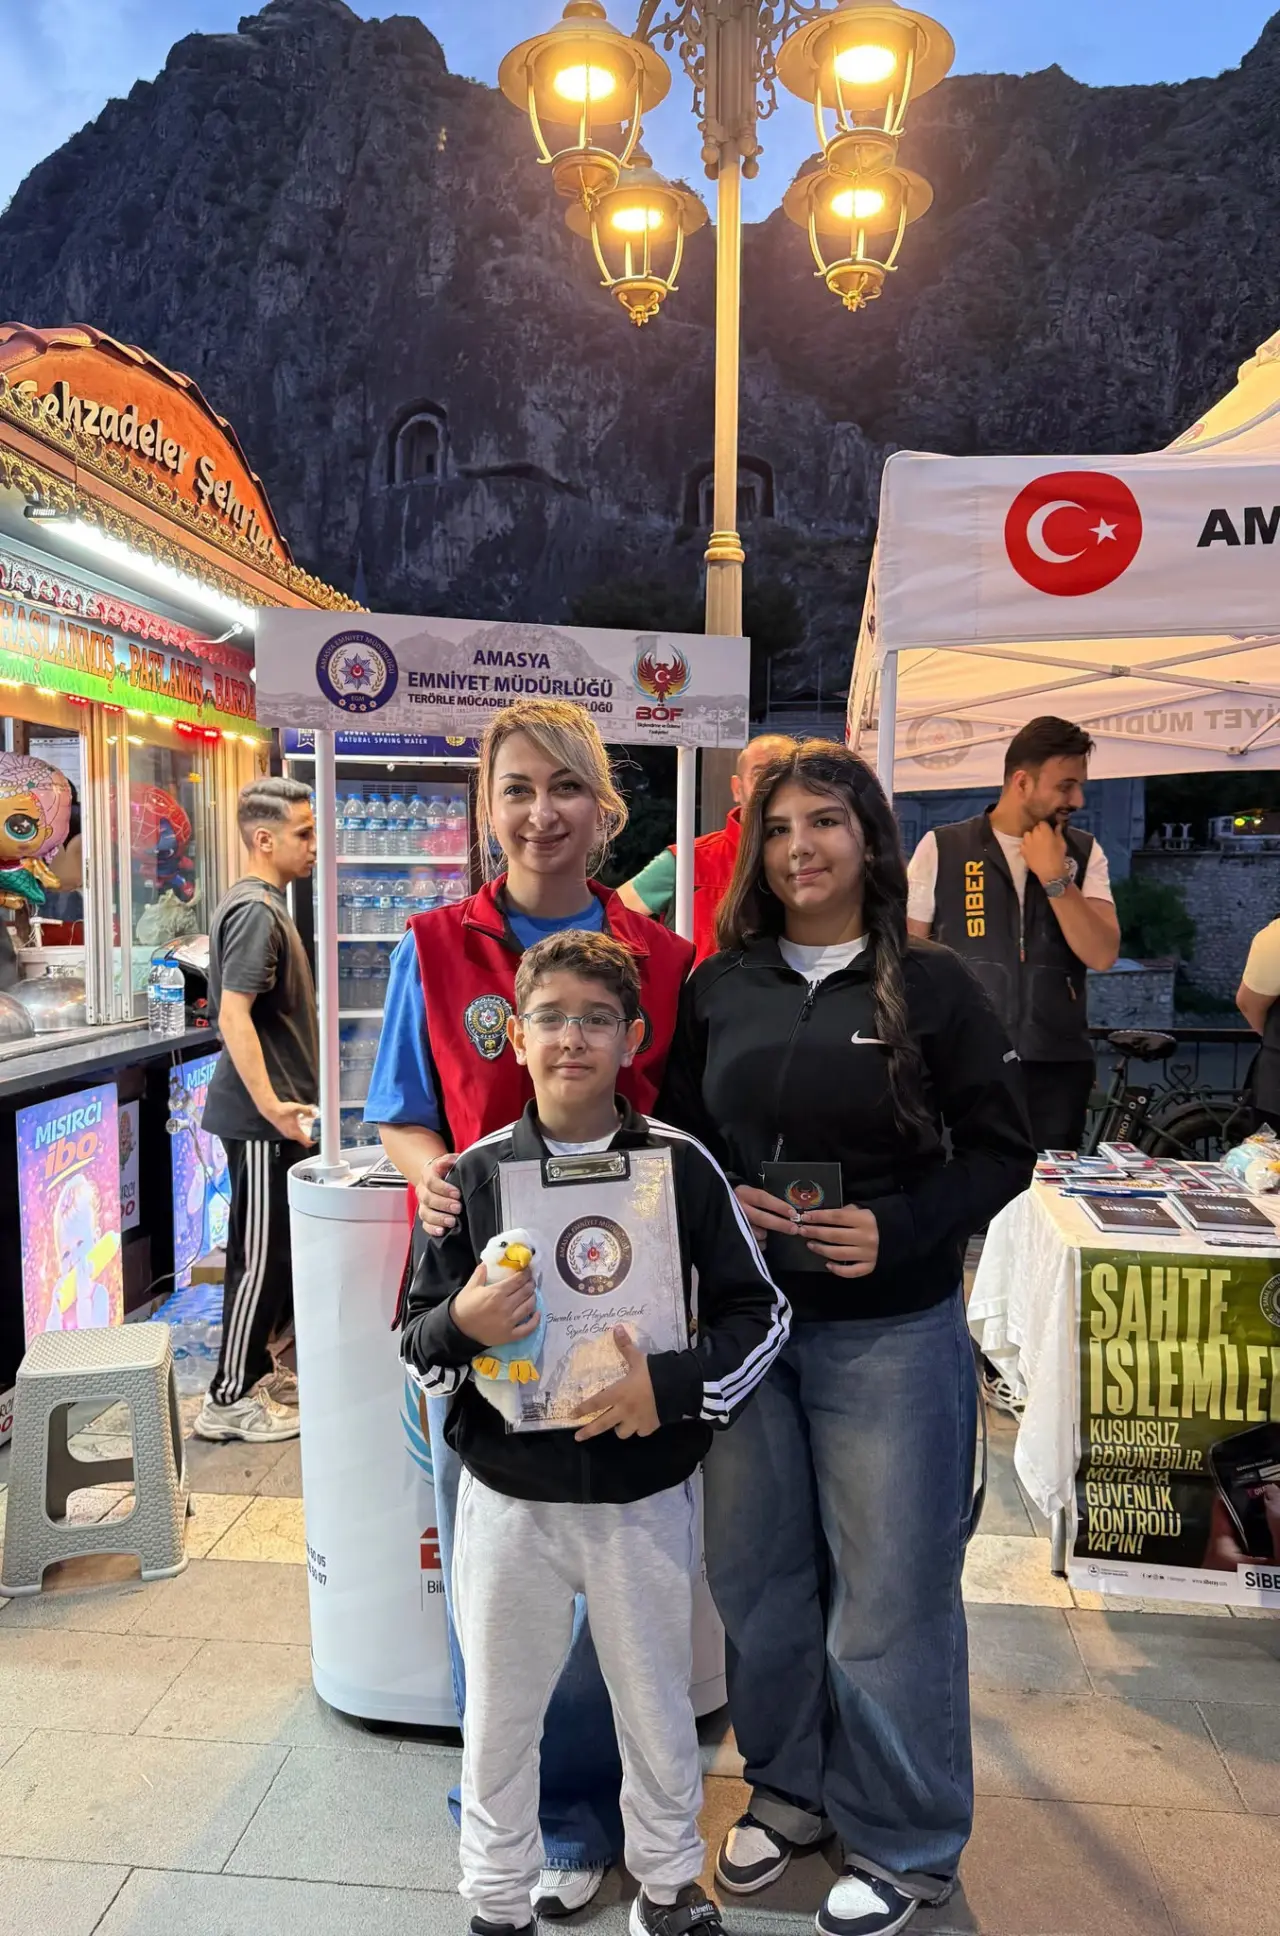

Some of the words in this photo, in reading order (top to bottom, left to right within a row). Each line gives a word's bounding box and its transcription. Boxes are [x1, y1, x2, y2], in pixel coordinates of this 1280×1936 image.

[1197, 506, 1280, 547] AM
[0, 601, 116, 693] HAŞLANMIŞ
[128, 643, 204, 717] PATLAMIŞ
[473, 650, 550, 669] AMASYA
[408, 671, 490, 692] EMNİYET
[494, 675, 613, 698] MÜDÜRLÜĞÜ
[408, 693, 455, 706] TERÖRLE
[457, 696, 515, 708] MÜCADELE
[635, 703, 684, 721] BÖF
[338, 736, 371, 744] NATURAL
[404, 737, 428, 745] WATER
[35, 1101, 102, 1149] MISIRCI
[45, 1131, 97, 1179] ibo
[1090, 1263, 1231, 1345] SAHTE
[1090, 1418, 1181, 1448] KUSURSUZ
[1090, 1444, 1204, 1471] GÖRÜNEBİLİR.
[1086, 1466, 1170, 1486] MUTLAKA
[1085, 1482, 1174, 1512] GÜVENLİK
[1088, 1507, 1182, 1537] KONTROLÜ
[1087, 1532, 1144, 1555] YAPIN!
